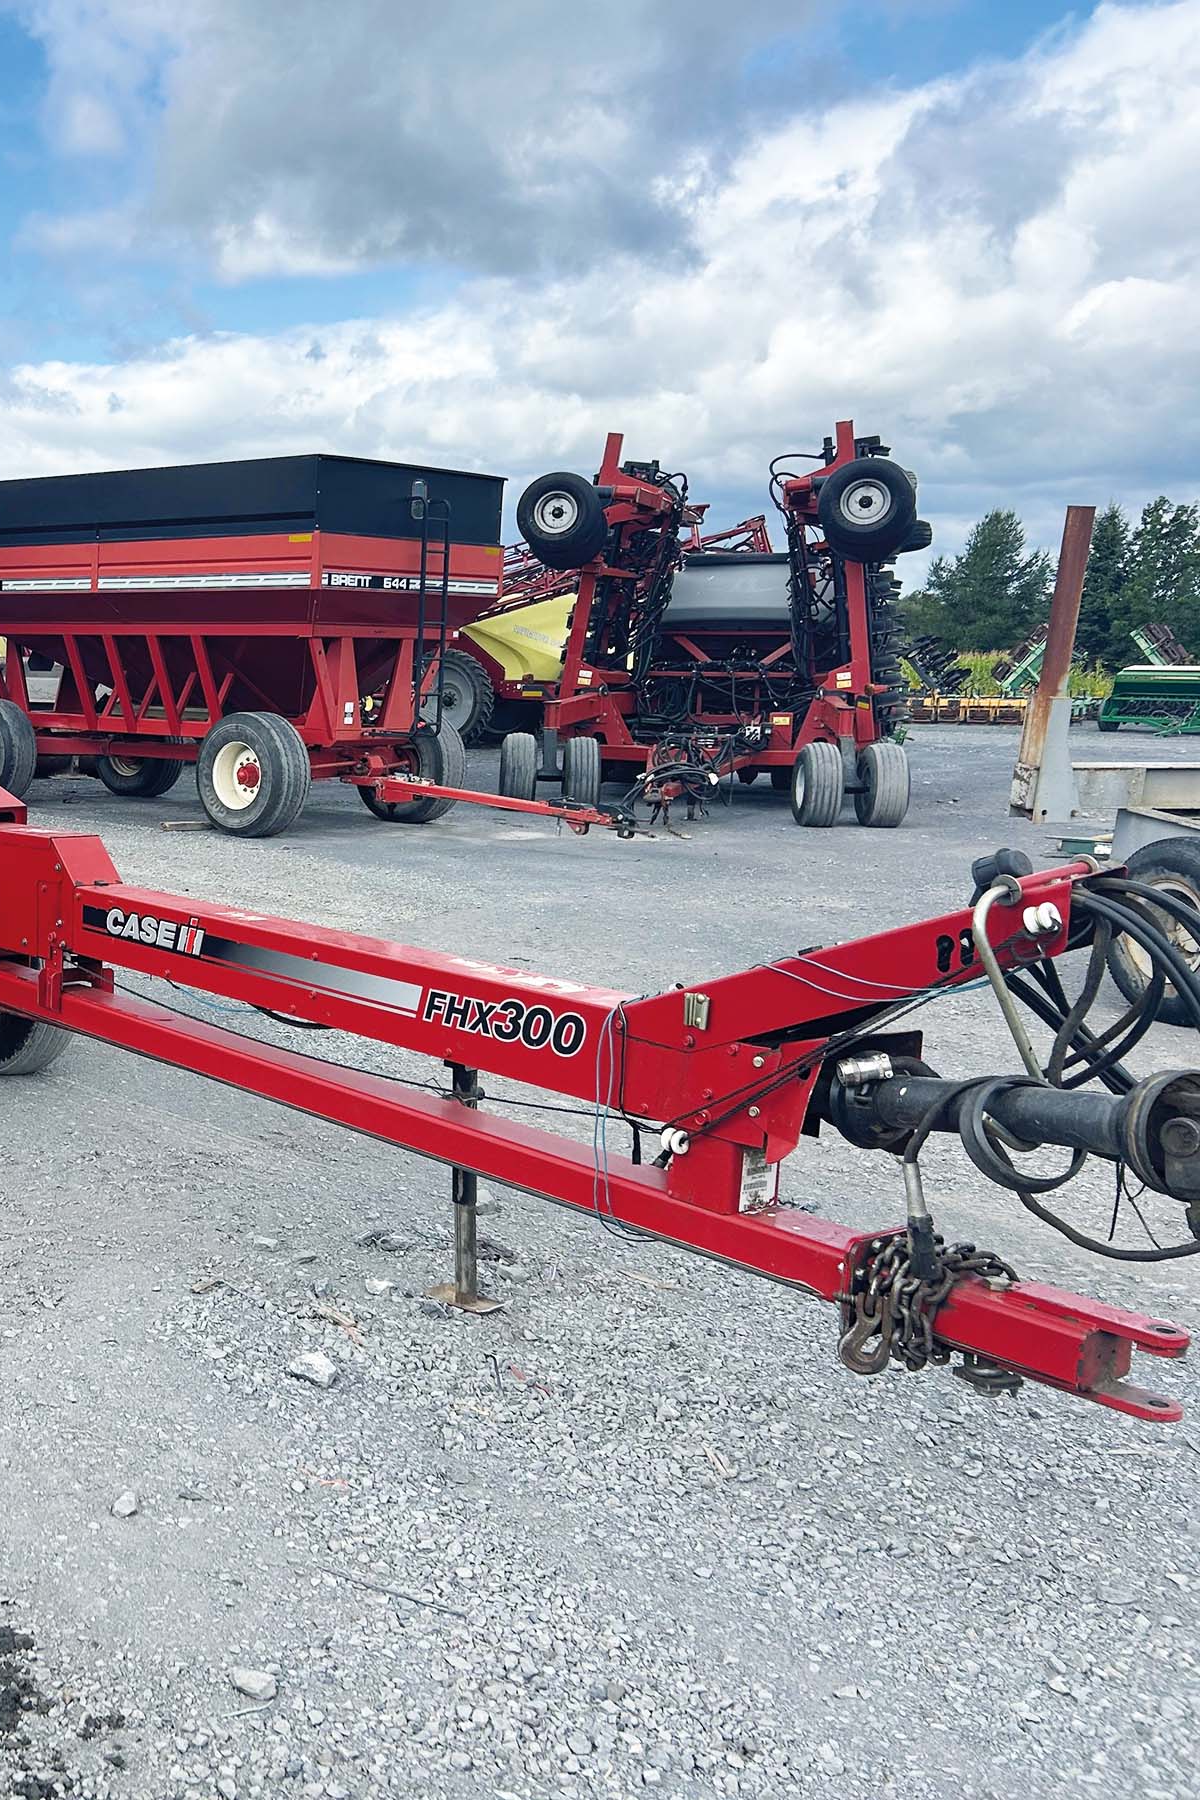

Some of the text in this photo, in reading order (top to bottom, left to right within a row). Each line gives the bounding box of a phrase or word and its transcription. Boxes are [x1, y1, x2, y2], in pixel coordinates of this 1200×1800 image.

[330, 573, 407, 590] BRENT 644
[422, 988, 587, 1058] FHX300
